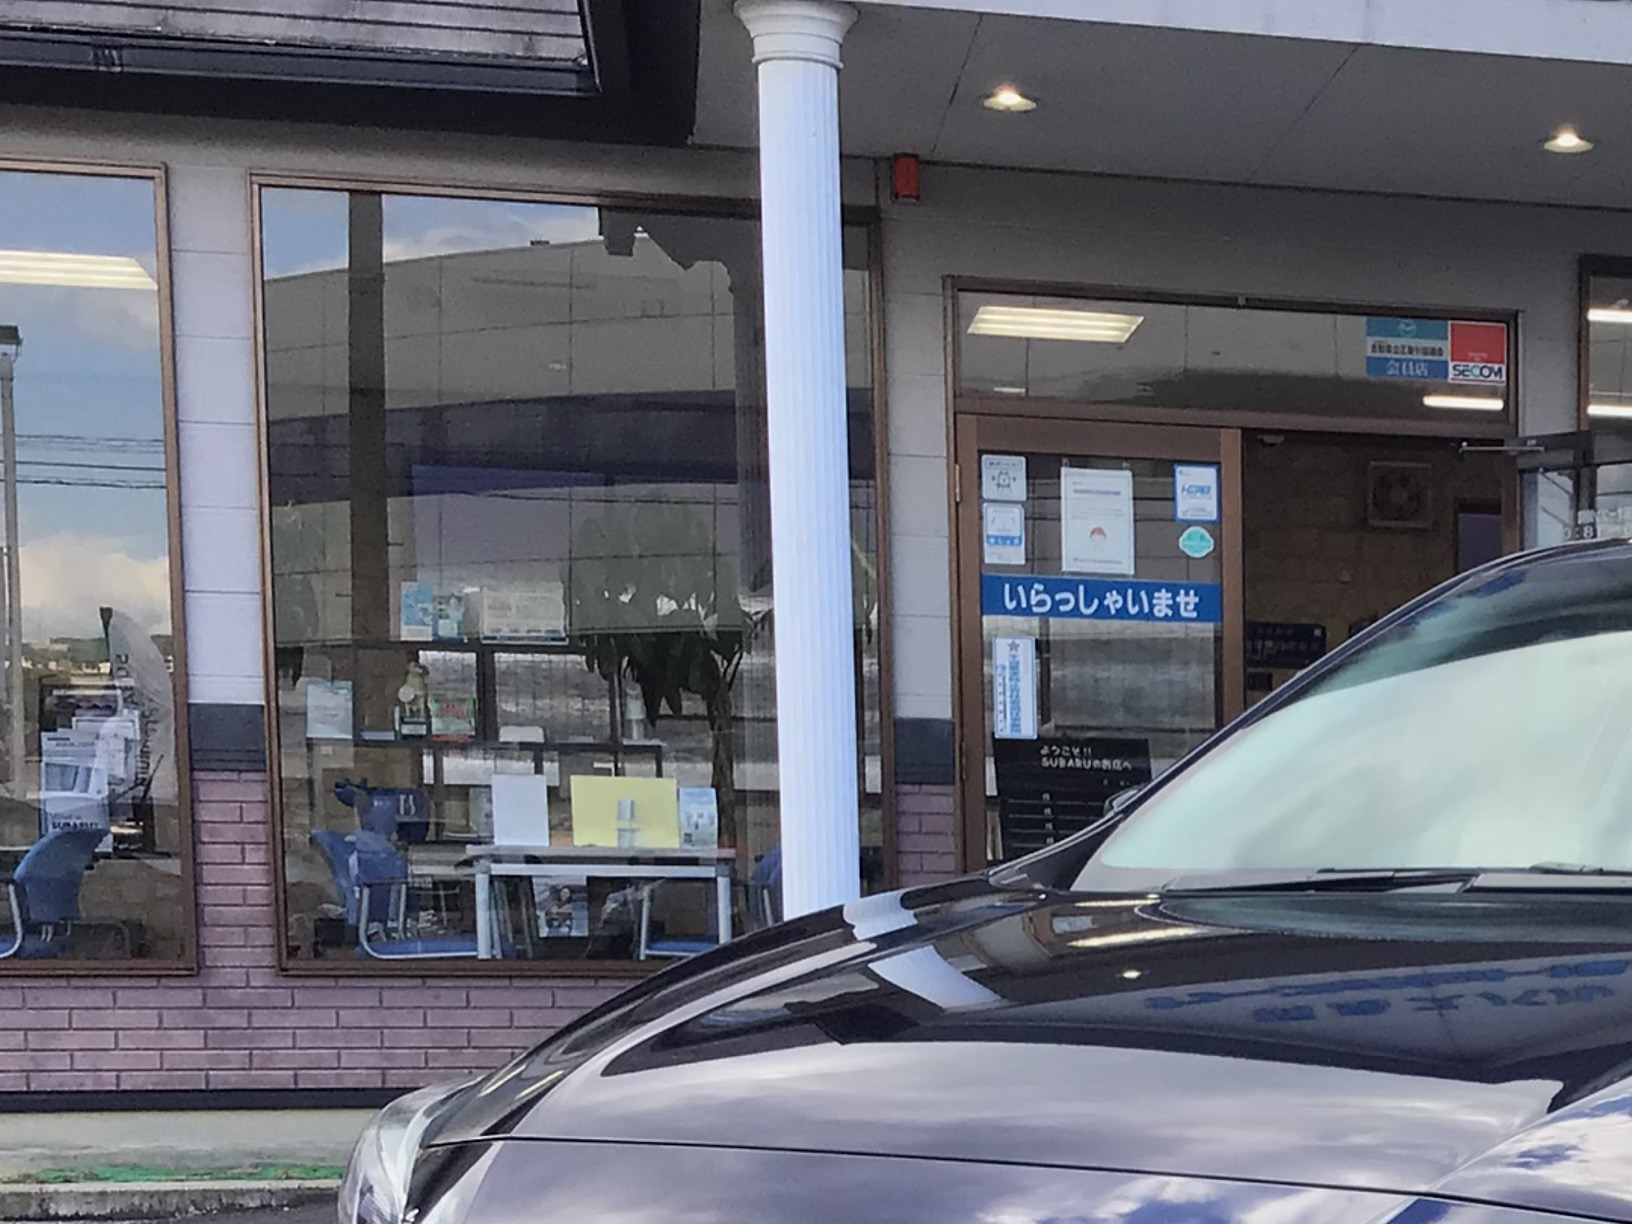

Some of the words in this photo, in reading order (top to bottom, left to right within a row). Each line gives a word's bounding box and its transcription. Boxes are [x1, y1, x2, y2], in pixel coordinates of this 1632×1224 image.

[1452, 364, 1503, 379] SECOM
[1003, 582, 1200, 619] いらっしゃいませ
